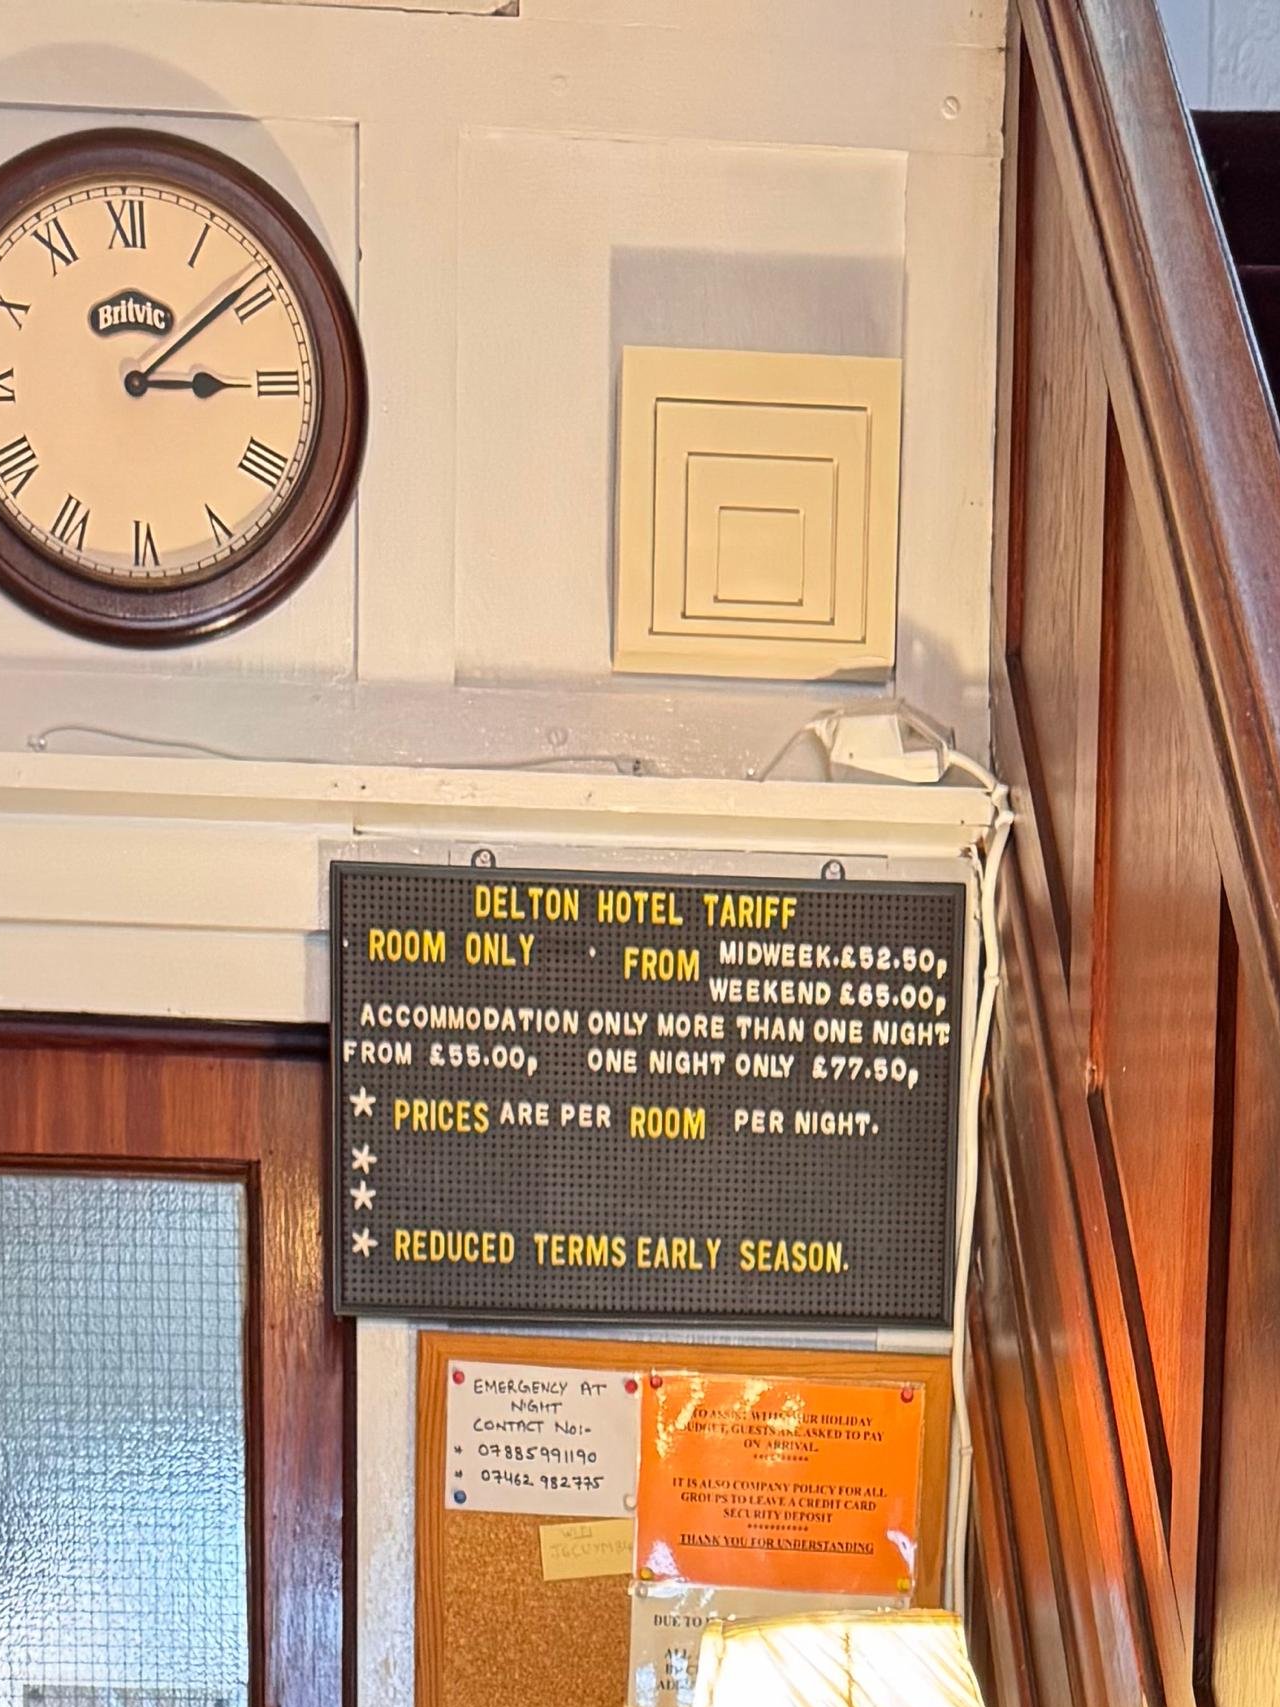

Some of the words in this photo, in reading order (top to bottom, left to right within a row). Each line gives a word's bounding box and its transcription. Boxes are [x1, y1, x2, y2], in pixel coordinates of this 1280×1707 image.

[105, 199, 147, 250] XII
[32, 217, 80, 276] XI
[98, 297, 166, 331] Britvic
[234, 284, 275, 324] II
[257, 371, 299, 397] III
[50, 493, 91, 551] VII
[474, 885, 579, 921] DELTON
[597, 889, 683, 926] HOTEL
[703, 893, 797, 929] TARIFF
[369, 929, 446, 962] ROOM
[465, 931, 535, 966] ONLY
[624, 946, 699, 981] FROM
[709, 977, 831, 1005] WEEKEND
[840, 981, 946, 1015] £65.00p
[361, 1003, 579, 1034] ACCOMMODATION
[588, 1010, 648, 1036] ONLY
[657, 1012, 725, 1039] MORE
[736, 1015, 804, 1042] THAN
[813, 1018, 863, 1044] ONE
[343, 1040, 412, 1065] FROM
[429, 1041, 538, 1077] £55.00p
[587, 1048, 637, 1074] ONE
[649, 1050, 725, 1076] NIGHT
[735, 1053, 795, 1079] ONLY
[812, 1056, 918, 1090] £77.50p
[394, 1098, 490, 1133] PRICES
[500, 1101, 550, 1127] ARE
[561, 1102, 611, 1128] PER
[630, 1105, 706, 1140] ROOM
[734, 1108, 784, 1134] PER
[794, 1110, 879, 1136] NIGHT.
[394, 1229, 515, 1264] REDUCED
[534, 1232, 627, 1267] TERMS
[637, 1236, 721, 1271] EARLY
[739, 1238, 849, 1273] SEASON.
[474, 1379, 567, 1395] EMERGENCY
[580, 1381, 607, 1395] AT
[510, 1399, 562, 1413] NIGHT
[821, 1414, 873, 1427] HOLIDAY
[473, 1418, 544, 1433] CONTACT
[680, 1422, 729, 1434] UDGET,
[805, 1427, 842, 1440] ASKED
[844, 1430, 860, 1441] TO
[863, 1431, 884, 1442] PAY
[744, 1438, 761, 1449] ON
[673, 1477, 683, 1488] IT
[686, 1477, 698, 1488] IS
[700, 1478, 731, 1490] ALSO
[732, 1480, 791, 1493] COMPANY
[793, 1483, 837, 1496] POLICY
[838, 1485, 862, 1497] FOR
[863, 1486, 888, 1498] ALL
[681, 1491, 729, 1504] GROUPS
[731, 1494, 747, 1505] TO
[749, 1495, 786, 1507] LEAVE
[797, 1497, 842, 1510] CREDIT
[843, 1499, 876, 1511] CARD
[723, 1508, 782, 1521] SECURITY
[784, 1511, 833, 1523] DEPOSIT
[680, 1533, 721, 1545] THANK
[723, 1535, 749, 1547] YOU
[751, 1537, 775, 1549] FOR
[777, 1538, 874, 1553] UNDERSTANDING
[654, 1614, 681, 1627] DUE
[685, 1615, 702, 1628] TO
